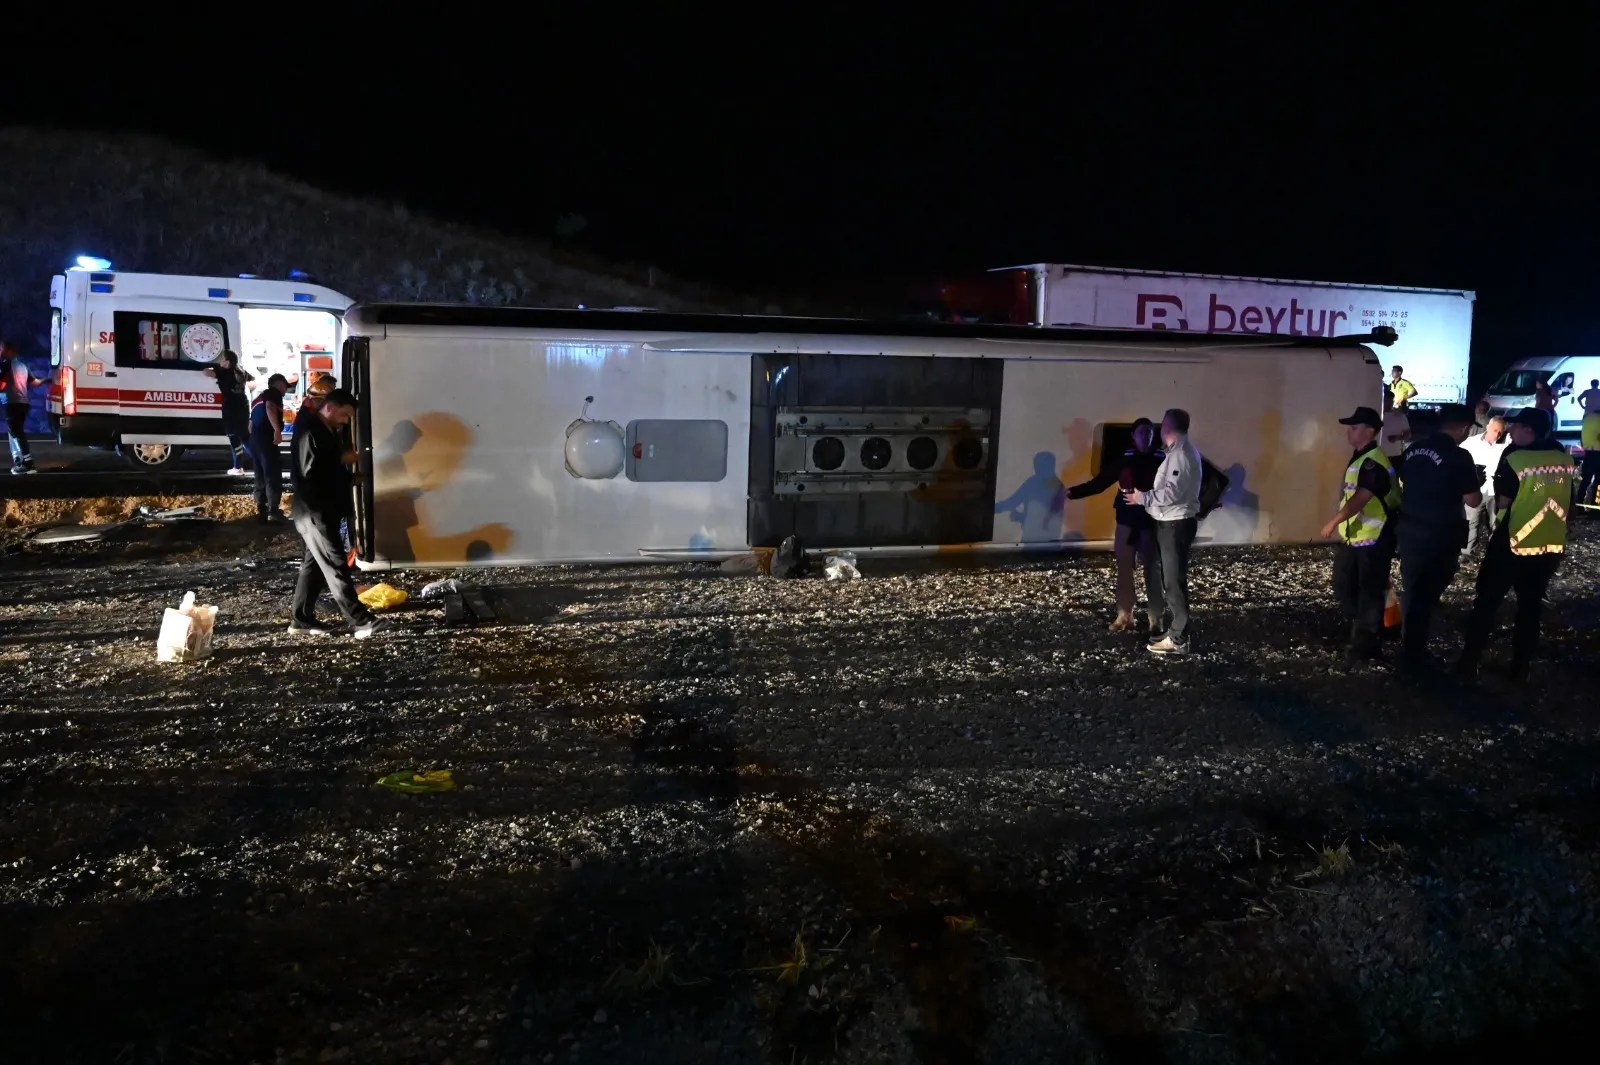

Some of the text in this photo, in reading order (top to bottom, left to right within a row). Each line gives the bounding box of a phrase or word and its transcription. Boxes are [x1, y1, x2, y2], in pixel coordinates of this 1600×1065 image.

[1207, 293, 1348, 337] beytur
[88, 363, 101, 371] 112
[144, 391, 215, 403] AMBULANS
[1405, 448, 1442, 466] JANDARMA
